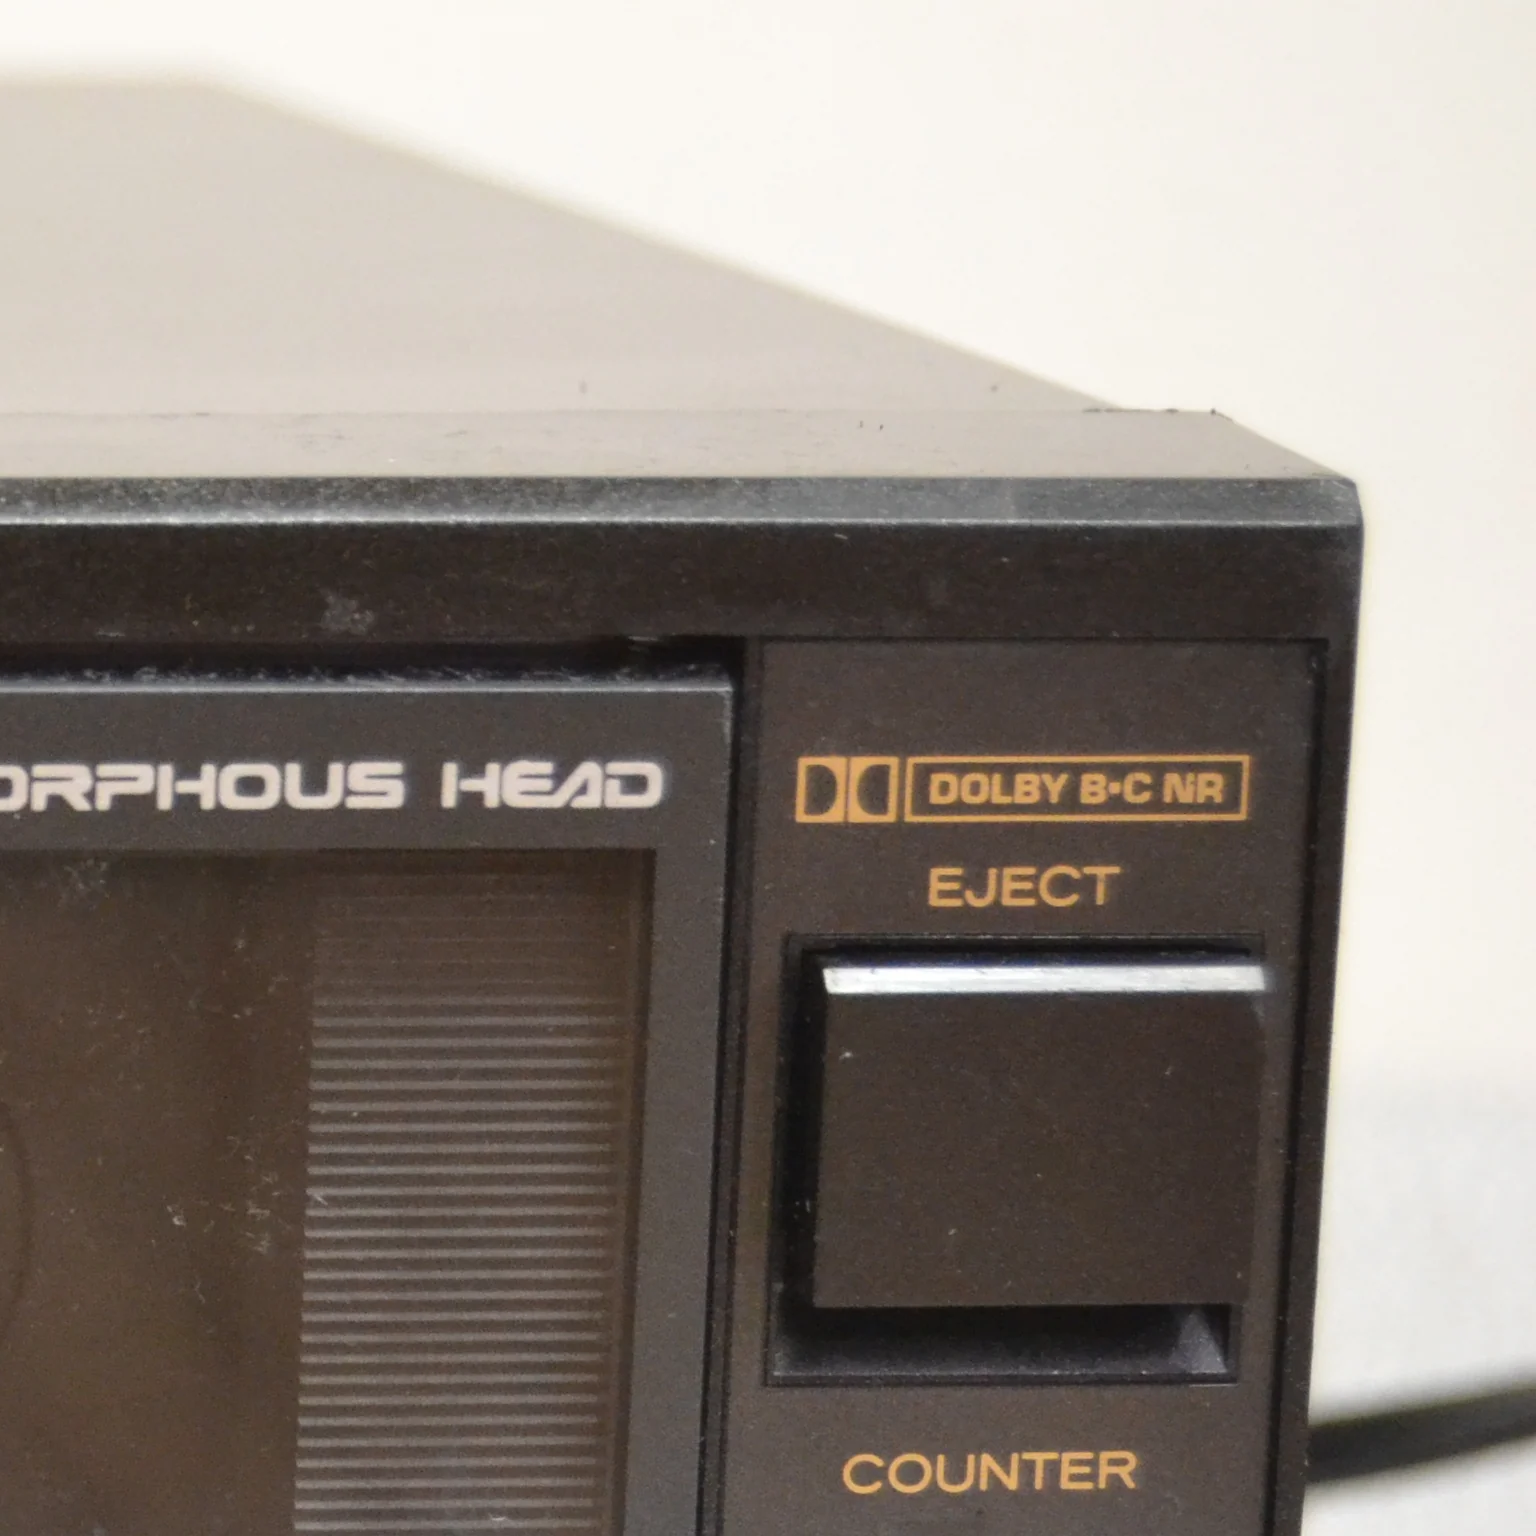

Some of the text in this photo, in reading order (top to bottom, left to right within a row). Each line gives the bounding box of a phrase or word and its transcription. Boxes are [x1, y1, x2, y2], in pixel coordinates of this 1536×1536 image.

[441, 761, 663, 808] HEAD
[928, 773, 1068, 804] DOLBY
[1163, 772, 1224, 803] NR
[928, 865, 1120, 907] EJECT
[842, 1451, 1137, 1495] COUNTER
